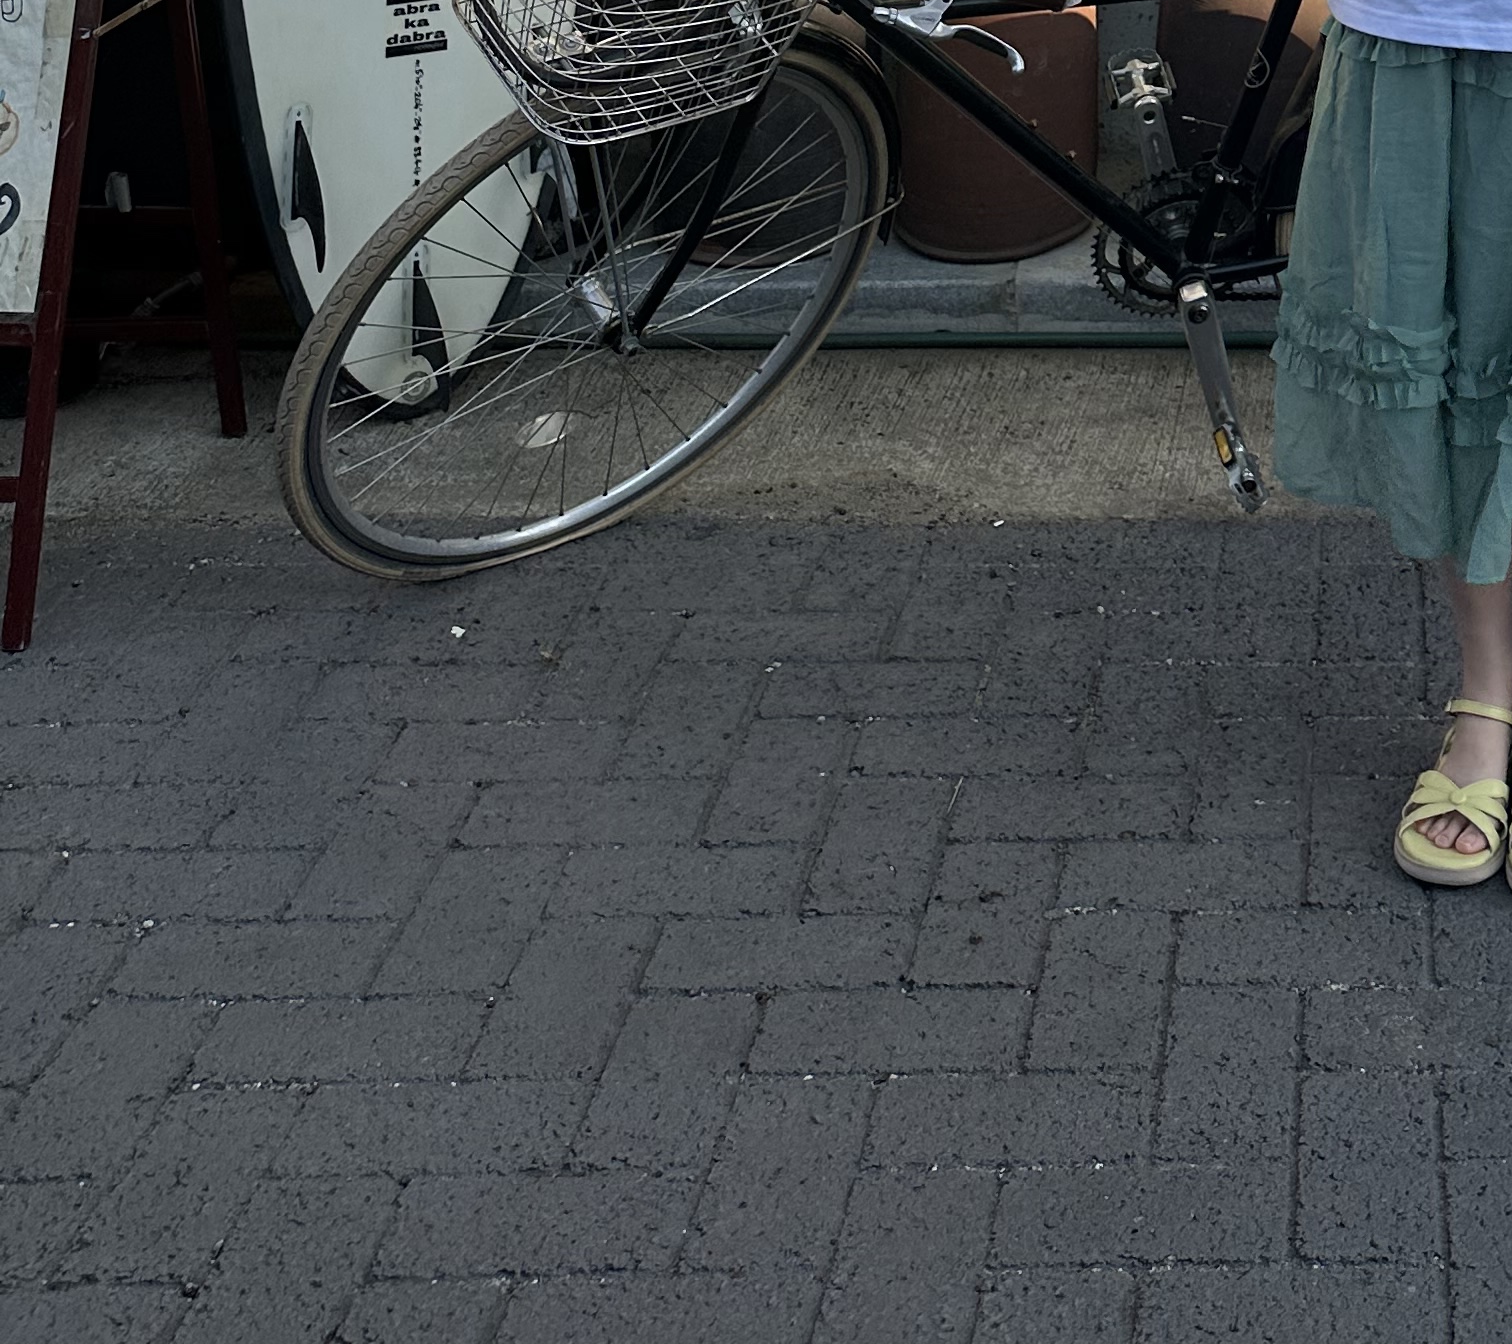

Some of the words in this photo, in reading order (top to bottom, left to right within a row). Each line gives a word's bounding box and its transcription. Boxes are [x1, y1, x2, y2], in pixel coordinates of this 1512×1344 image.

[393, 3, 441, 17] abra
[404, 18, 430, 29] ka
[386, 30, 446, 45] dabra
